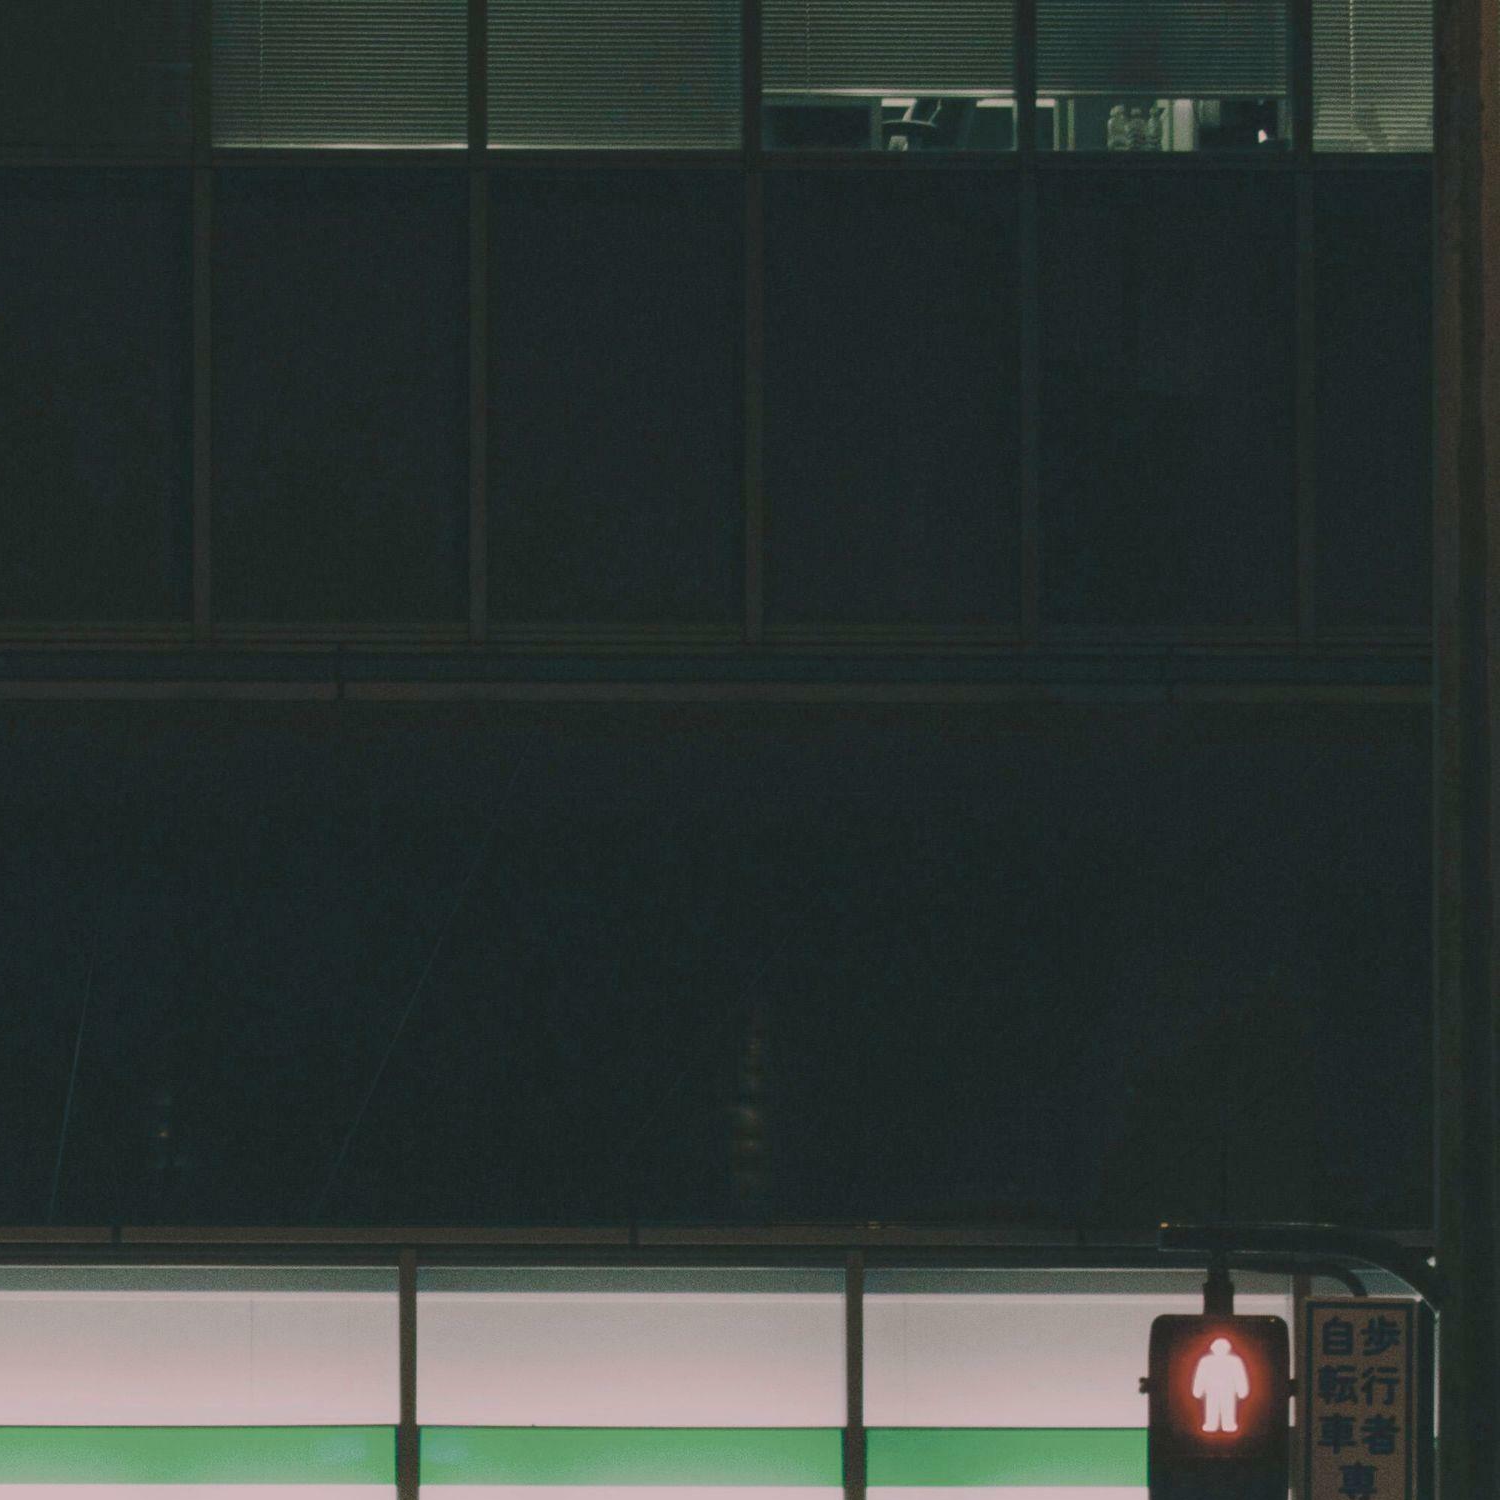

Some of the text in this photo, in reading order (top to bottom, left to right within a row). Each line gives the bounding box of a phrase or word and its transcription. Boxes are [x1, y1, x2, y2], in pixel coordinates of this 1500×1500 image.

[1317, 1316, 1358, 1455] 自転車
[1360, 1316, 1401, 1455] 歩行者
